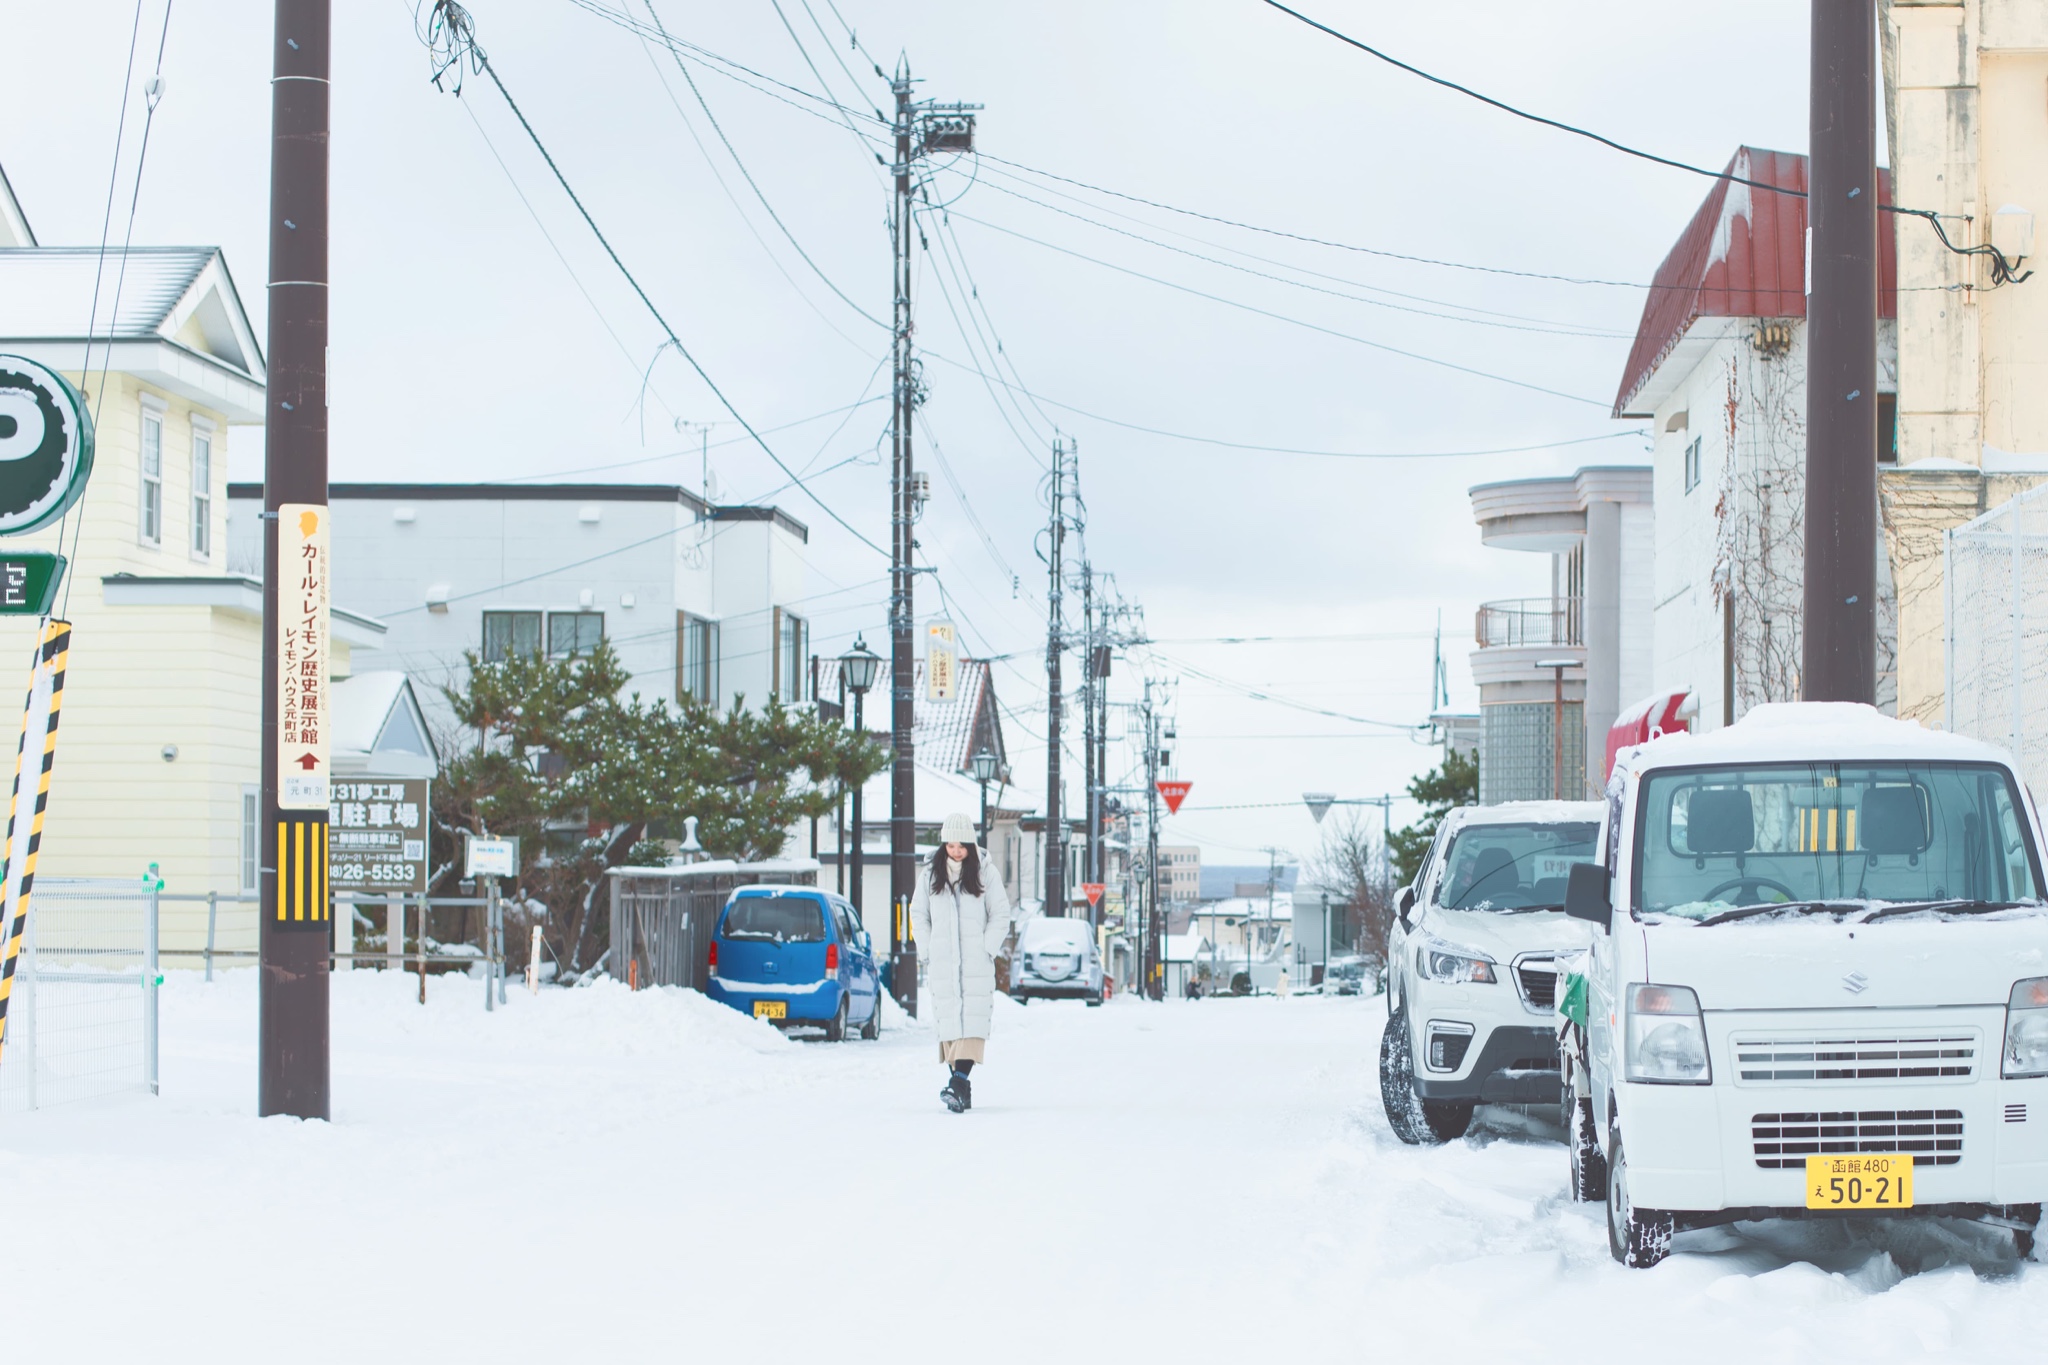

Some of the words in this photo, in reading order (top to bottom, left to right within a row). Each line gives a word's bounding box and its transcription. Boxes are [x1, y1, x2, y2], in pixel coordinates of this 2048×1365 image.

[300, 543, 319, 745] カール・レイモン歴史展示館
[284, 627, 298, 744] レイモン・ハウス元町店
[339, 832, 400, 845] 無断駐車禁止
[330, 853, 362, 862] チュリー21
[1832, 1159, 1861, 1173] 函館
[1863, 1159, 1889, 1173] 480
[1815, 1185, 1824, 1198] え
[1830, 1177, 1903, 1204] 50-21
